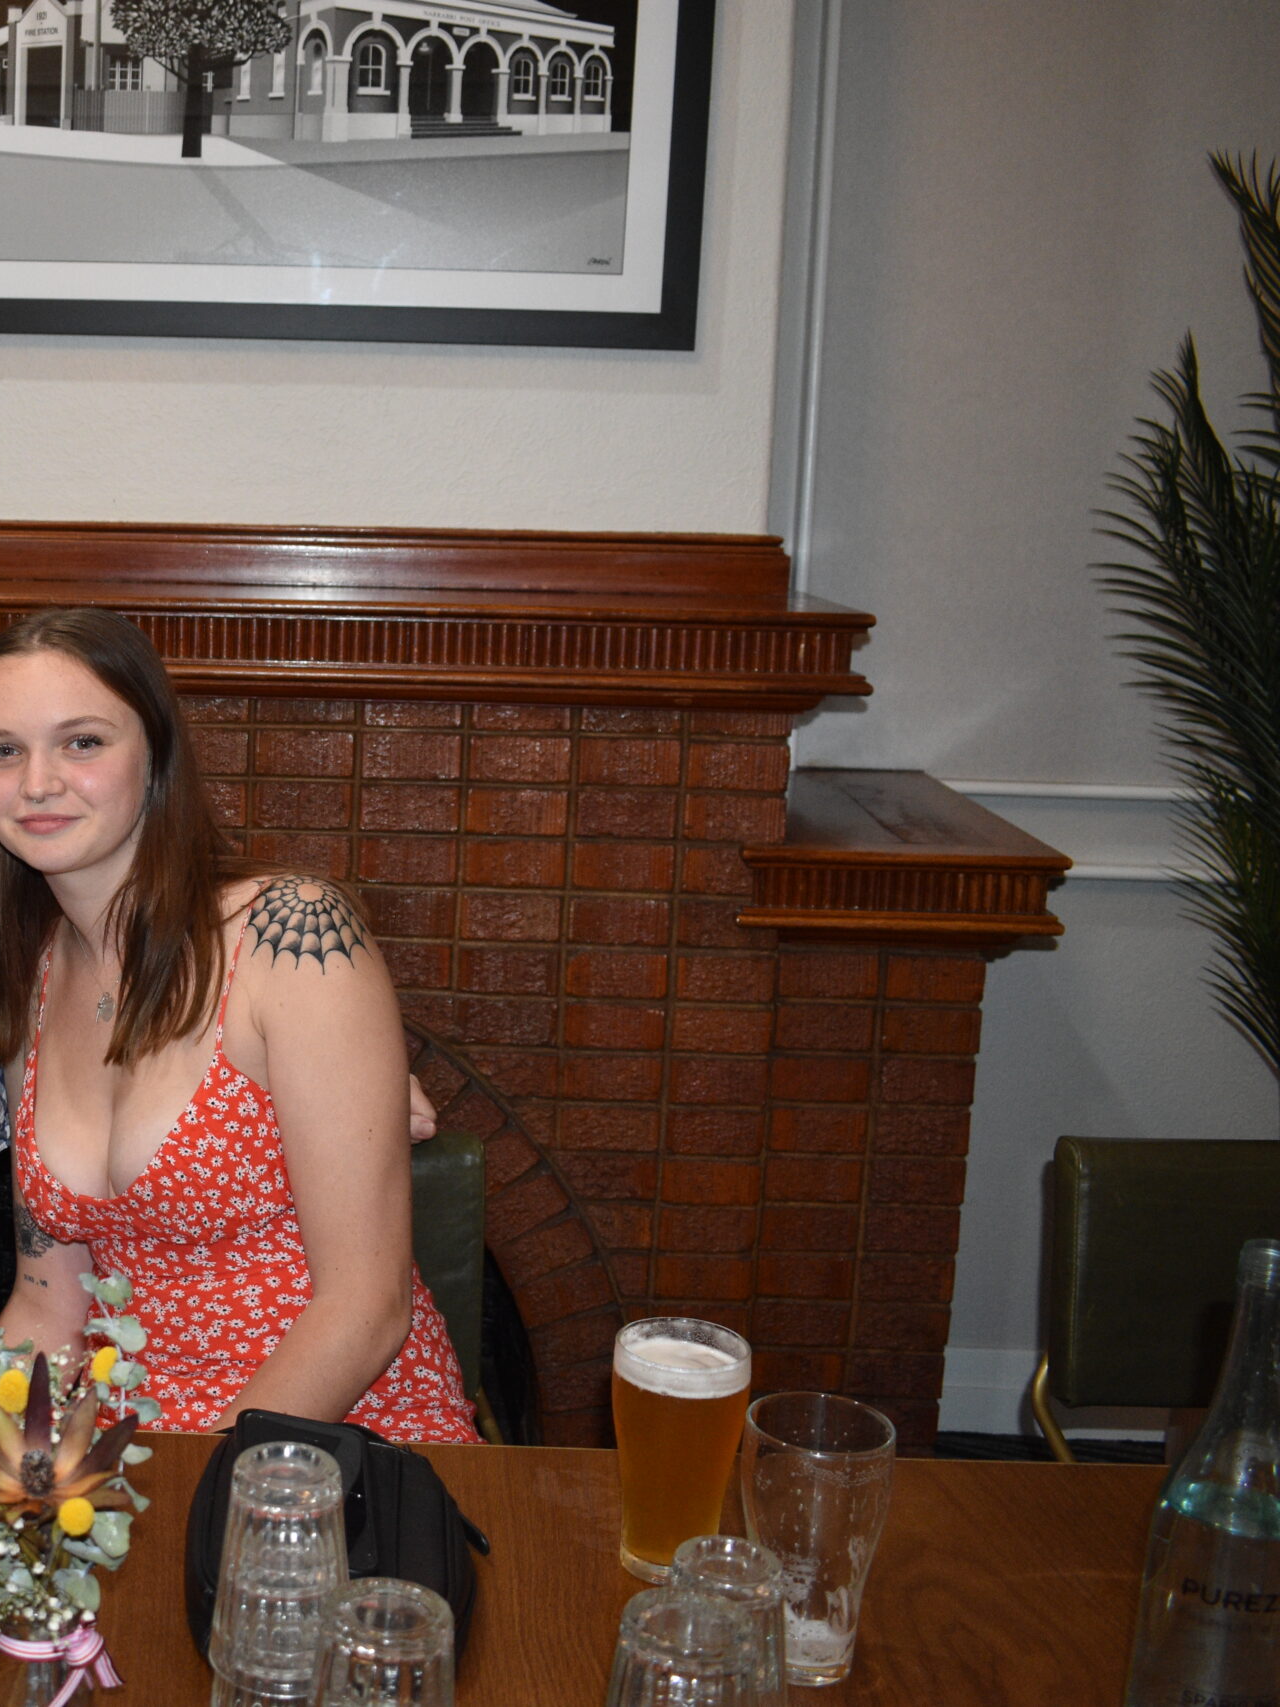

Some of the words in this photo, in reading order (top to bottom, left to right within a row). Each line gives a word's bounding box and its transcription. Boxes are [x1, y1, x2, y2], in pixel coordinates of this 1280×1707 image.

[459, 16, 475, 24] POST
[37, 27, 58, 36] STATION
[1181, 1576, 1280, 1613] PUREZ
